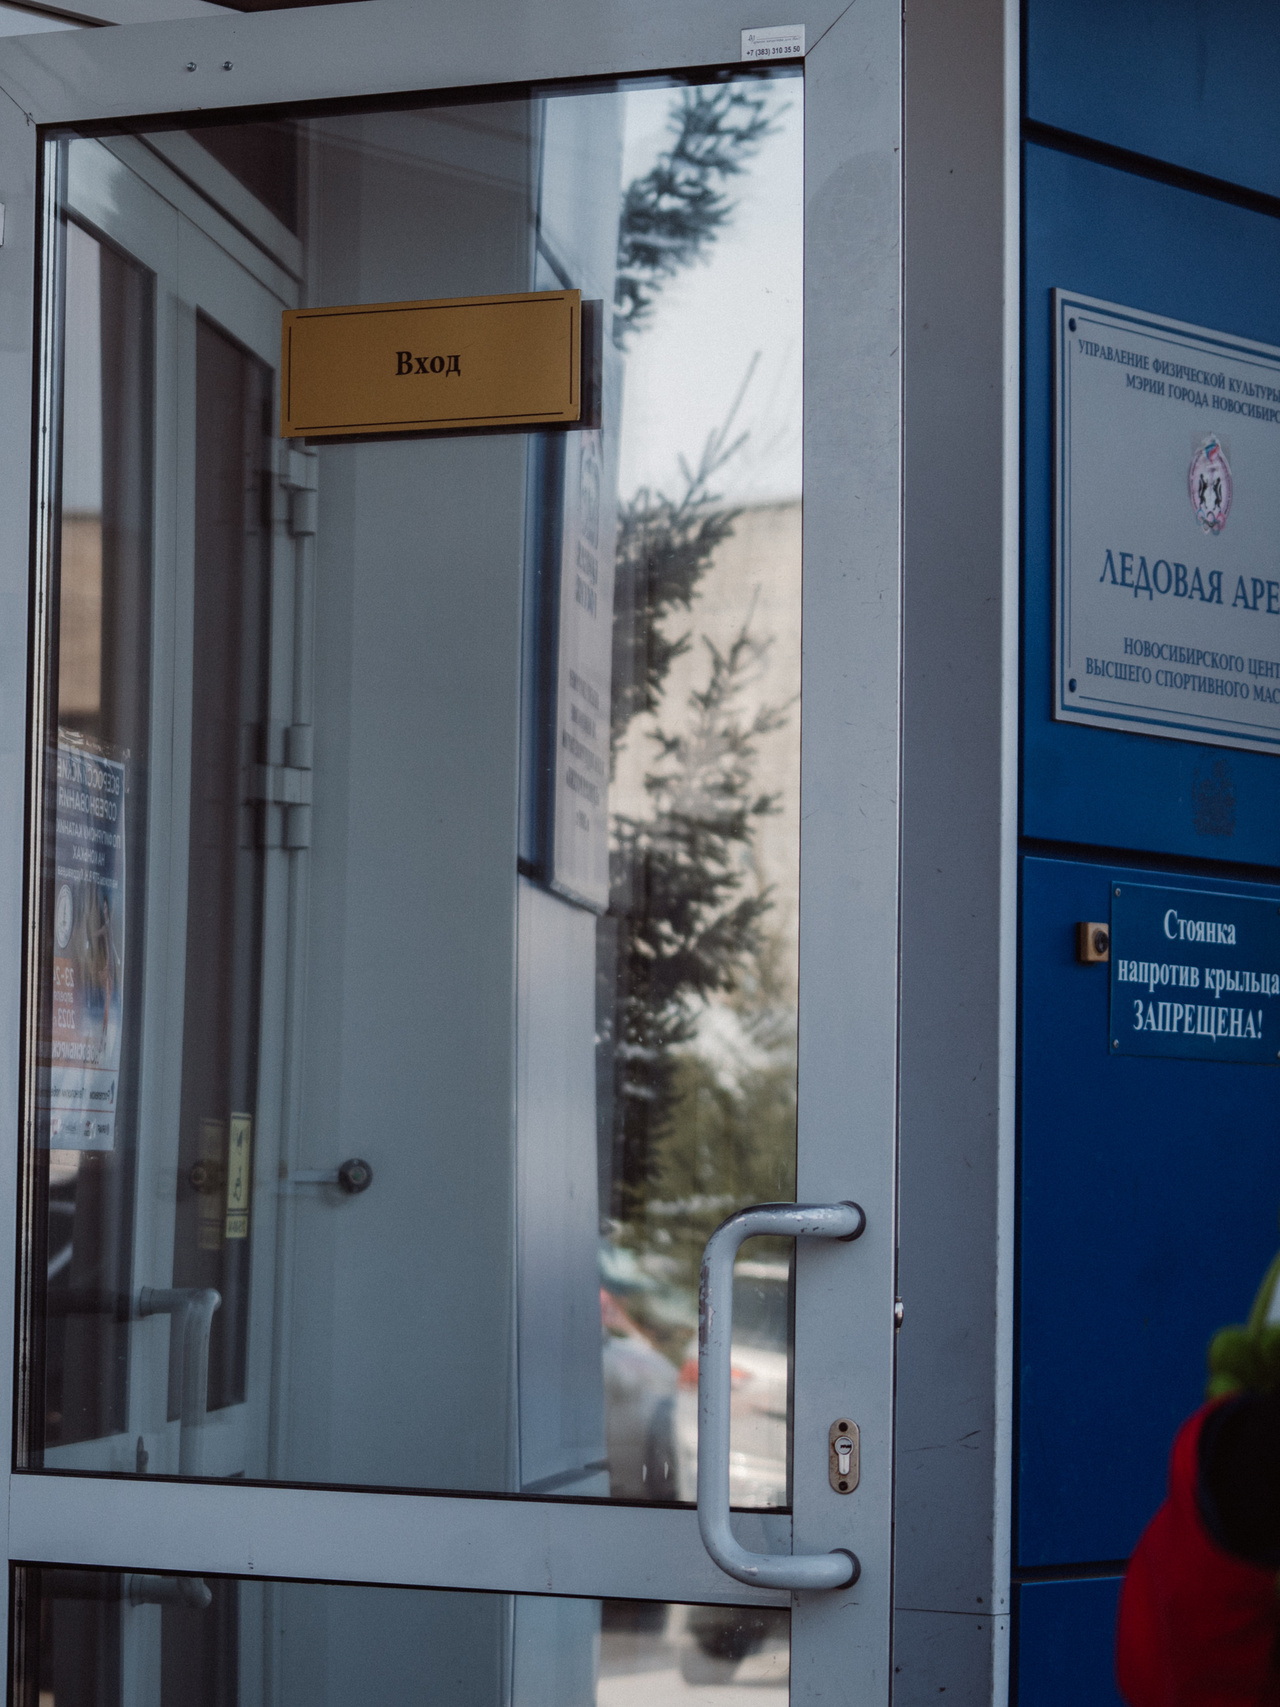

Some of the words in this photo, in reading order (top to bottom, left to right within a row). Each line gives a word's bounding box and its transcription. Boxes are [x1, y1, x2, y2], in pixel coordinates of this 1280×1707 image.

[755, 47, 770, 57] (383)
[784, 45, 792, 53] 35
[793, 45, 801, 53] 50
[394, 350, 461, 377] Вход
[1078, 338, 1149, 370] УПРАВЛЕНИЕ
[1152, 357, 1226, 390] ФИЗИЧЕСКОЙ
[1229, 377, 1280, 404] КУЛЬТУРЫ
[1126, 373, 1165, 396] МЭРИИ
[1168, 383, 1209, 409] ГОРОДА
[1099, 548, 1223, 605] ЛЕДОВАЯ
[1232, 574, 1280, 615] АРЕ
[1123, 637, 1244, 673] НОВОСИБИРСКОГО
[1086, 657, 1152, 684] ВЫСШЕГО
[1155, 669, 1250, 699] СПОРТИВНОГО
[1253, 684, 1280, 705] МАС
[1163, 908, 1237, 945] Стоянка
[1118, 959, 1200, 993] напротив
[1204, 967, 1280, 999] крыльца
[1133, 999, 1264, 1043] ЗАПРЕЩЕНА!
